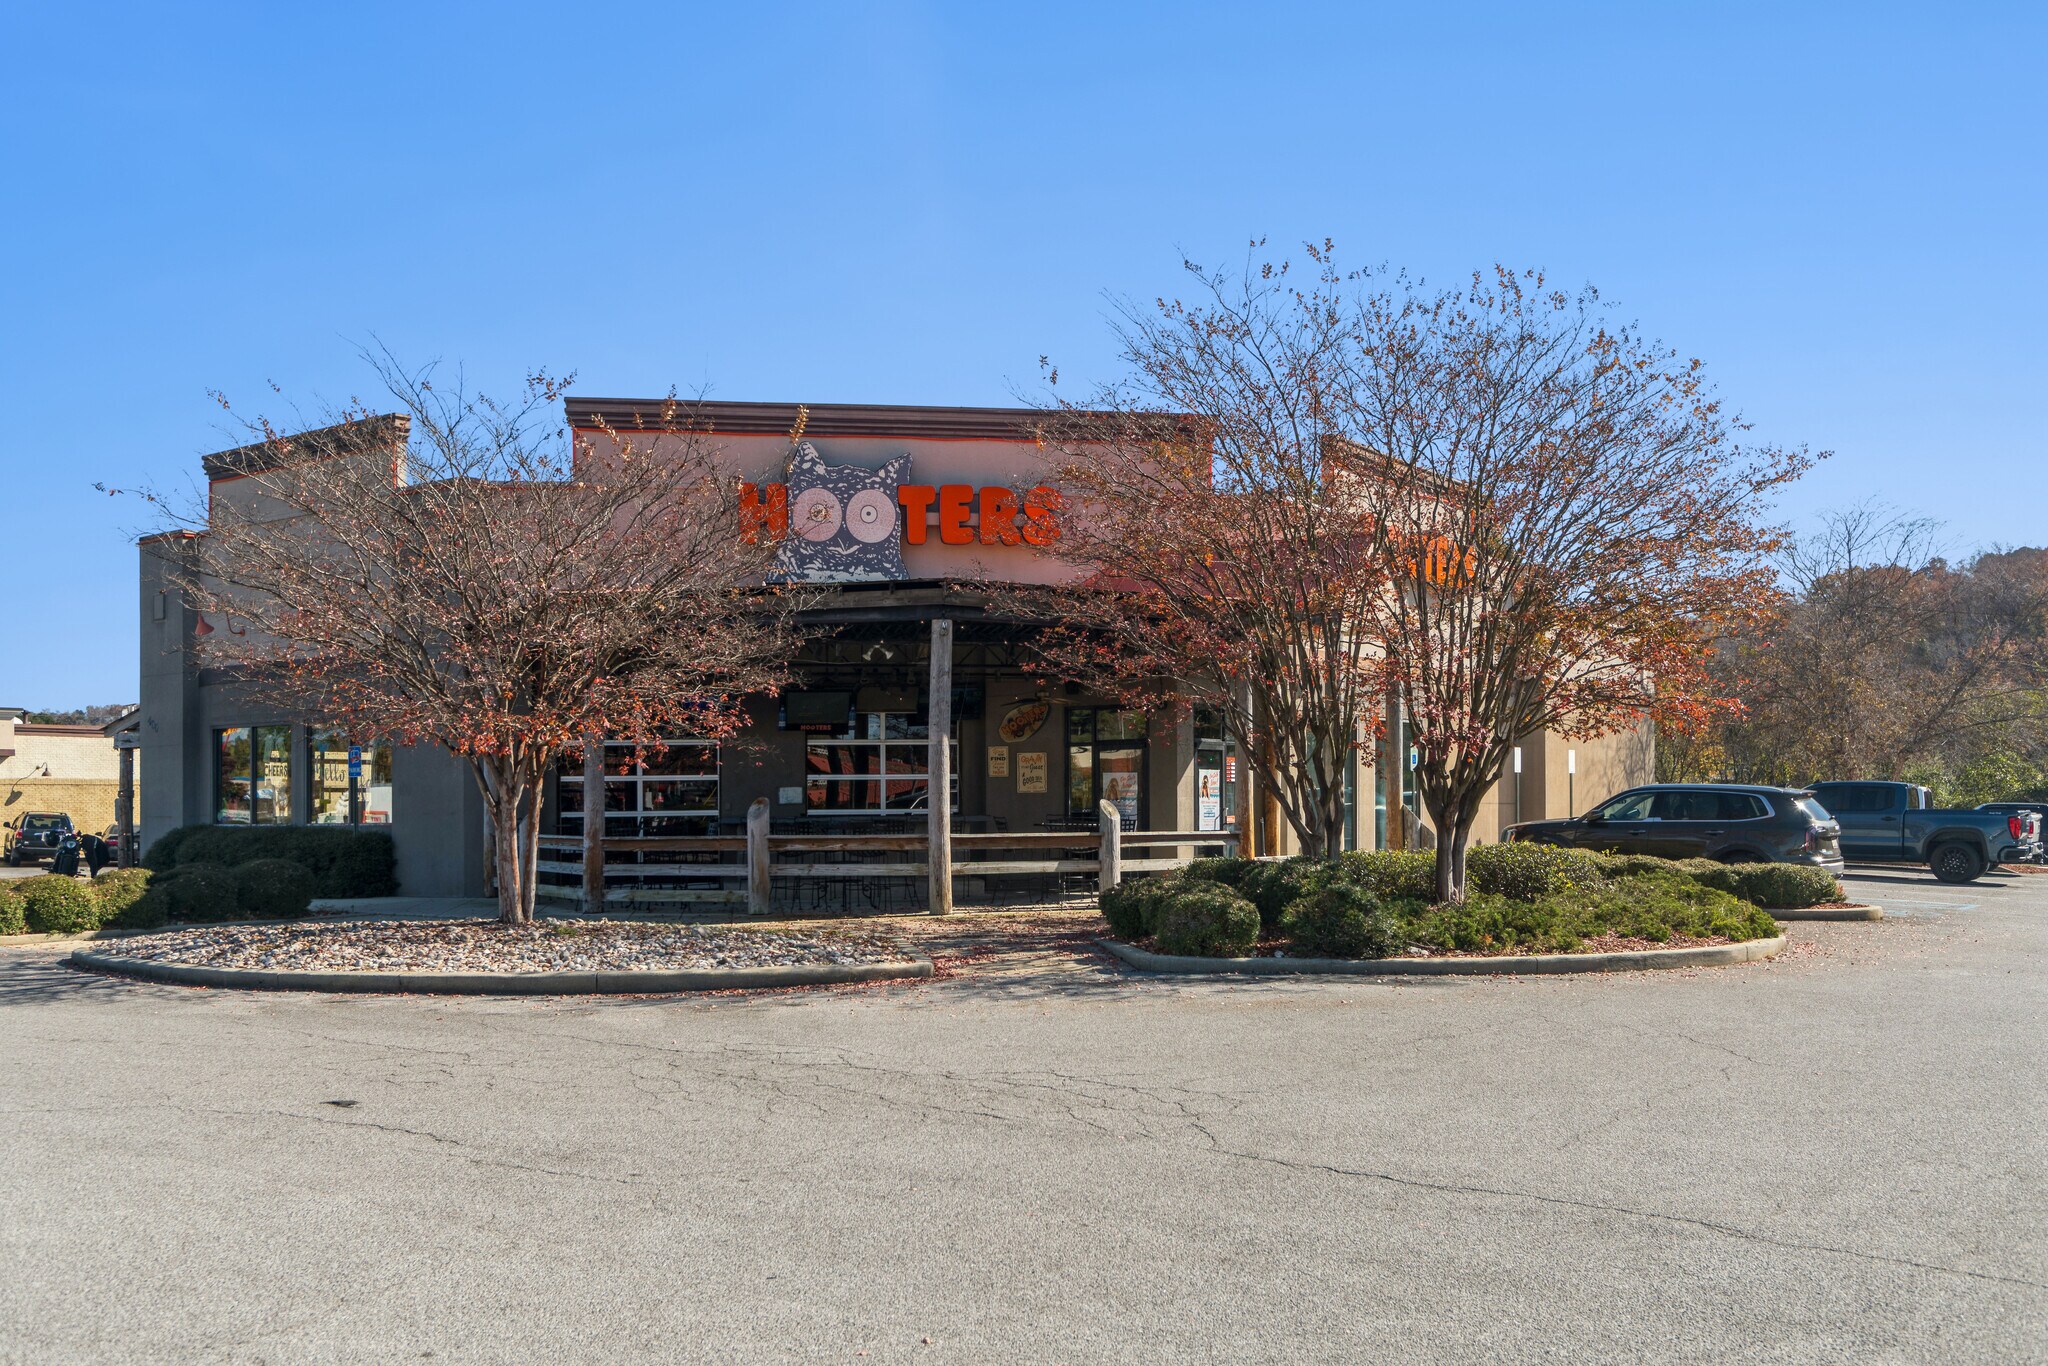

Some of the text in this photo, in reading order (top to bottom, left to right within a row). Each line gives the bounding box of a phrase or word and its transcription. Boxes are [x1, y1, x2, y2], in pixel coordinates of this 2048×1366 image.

[738, 482, 1063, 546] HOOTERS
[800, 724, 832, 732] HOOTERS
[264, 765, 288, 777] CHEERS
